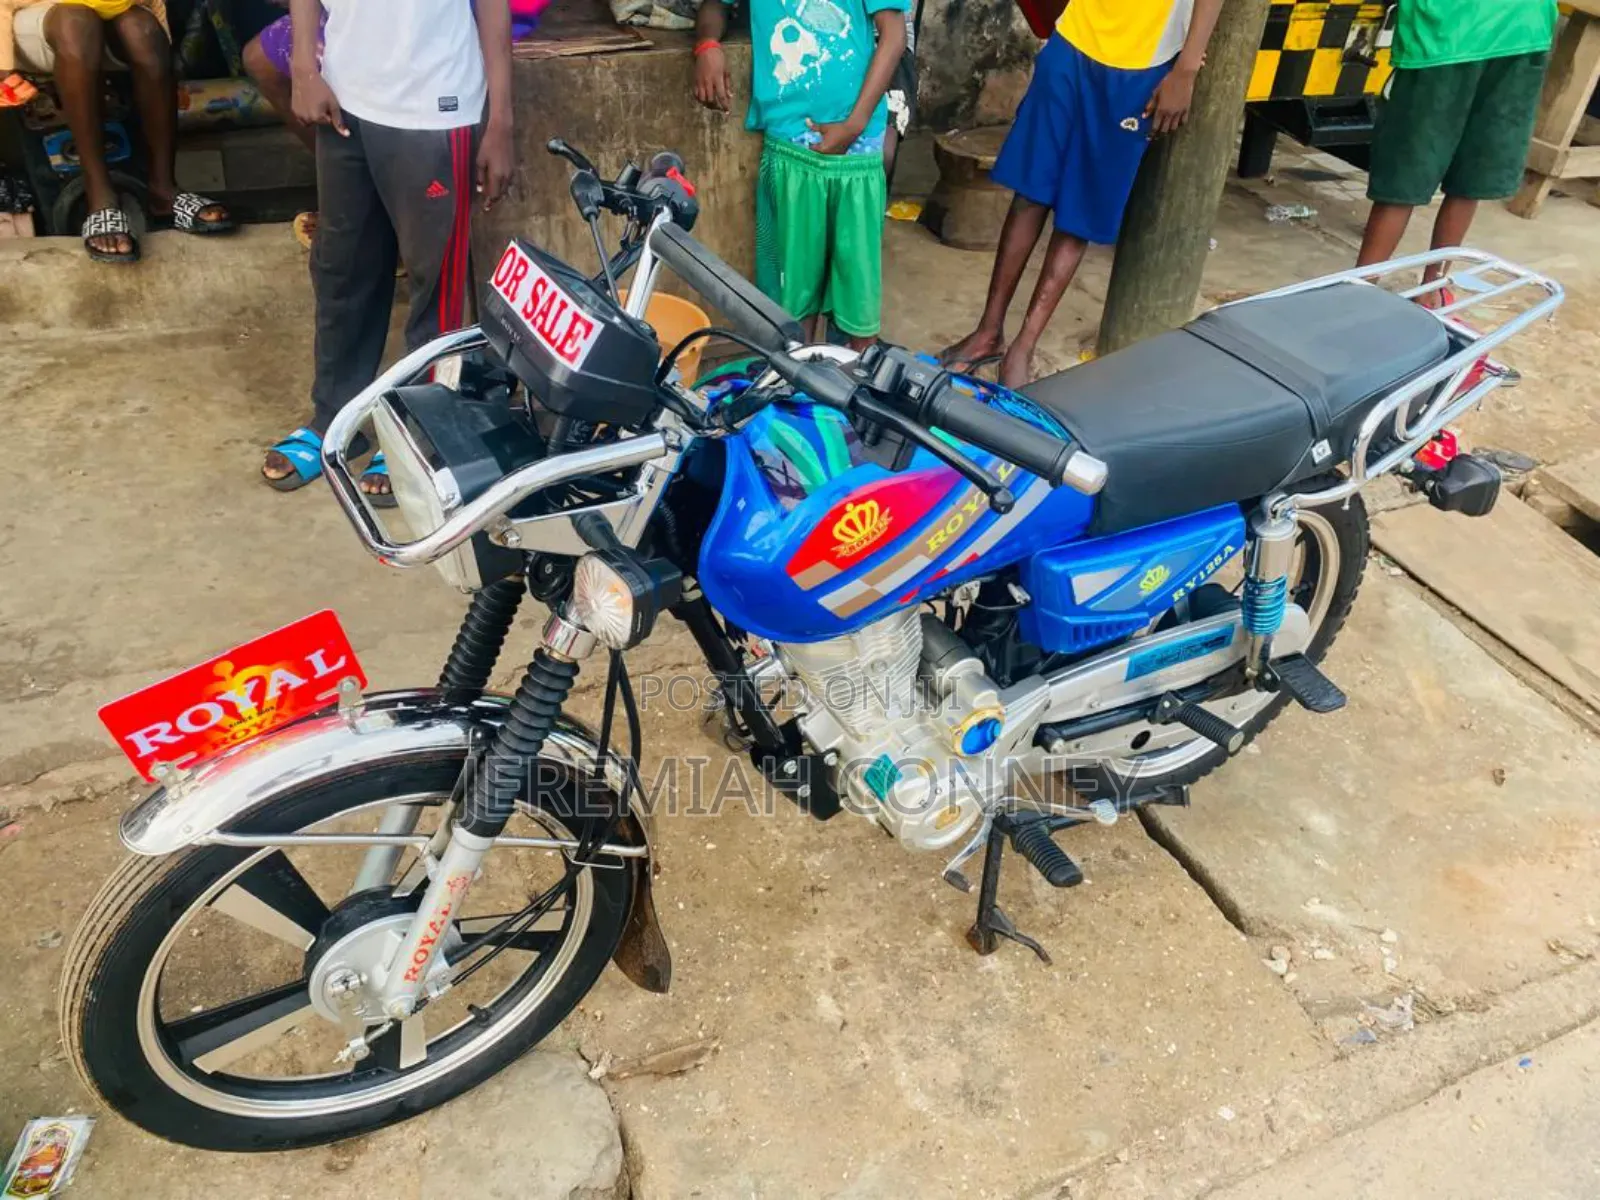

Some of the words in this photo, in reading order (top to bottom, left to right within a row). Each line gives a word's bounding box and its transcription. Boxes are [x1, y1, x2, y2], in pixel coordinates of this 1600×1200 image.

[521, 276, 595, 365] SALE
[125, 648, 346, 758] ROYAL
[404, 903, 452, 982] ROYAL
